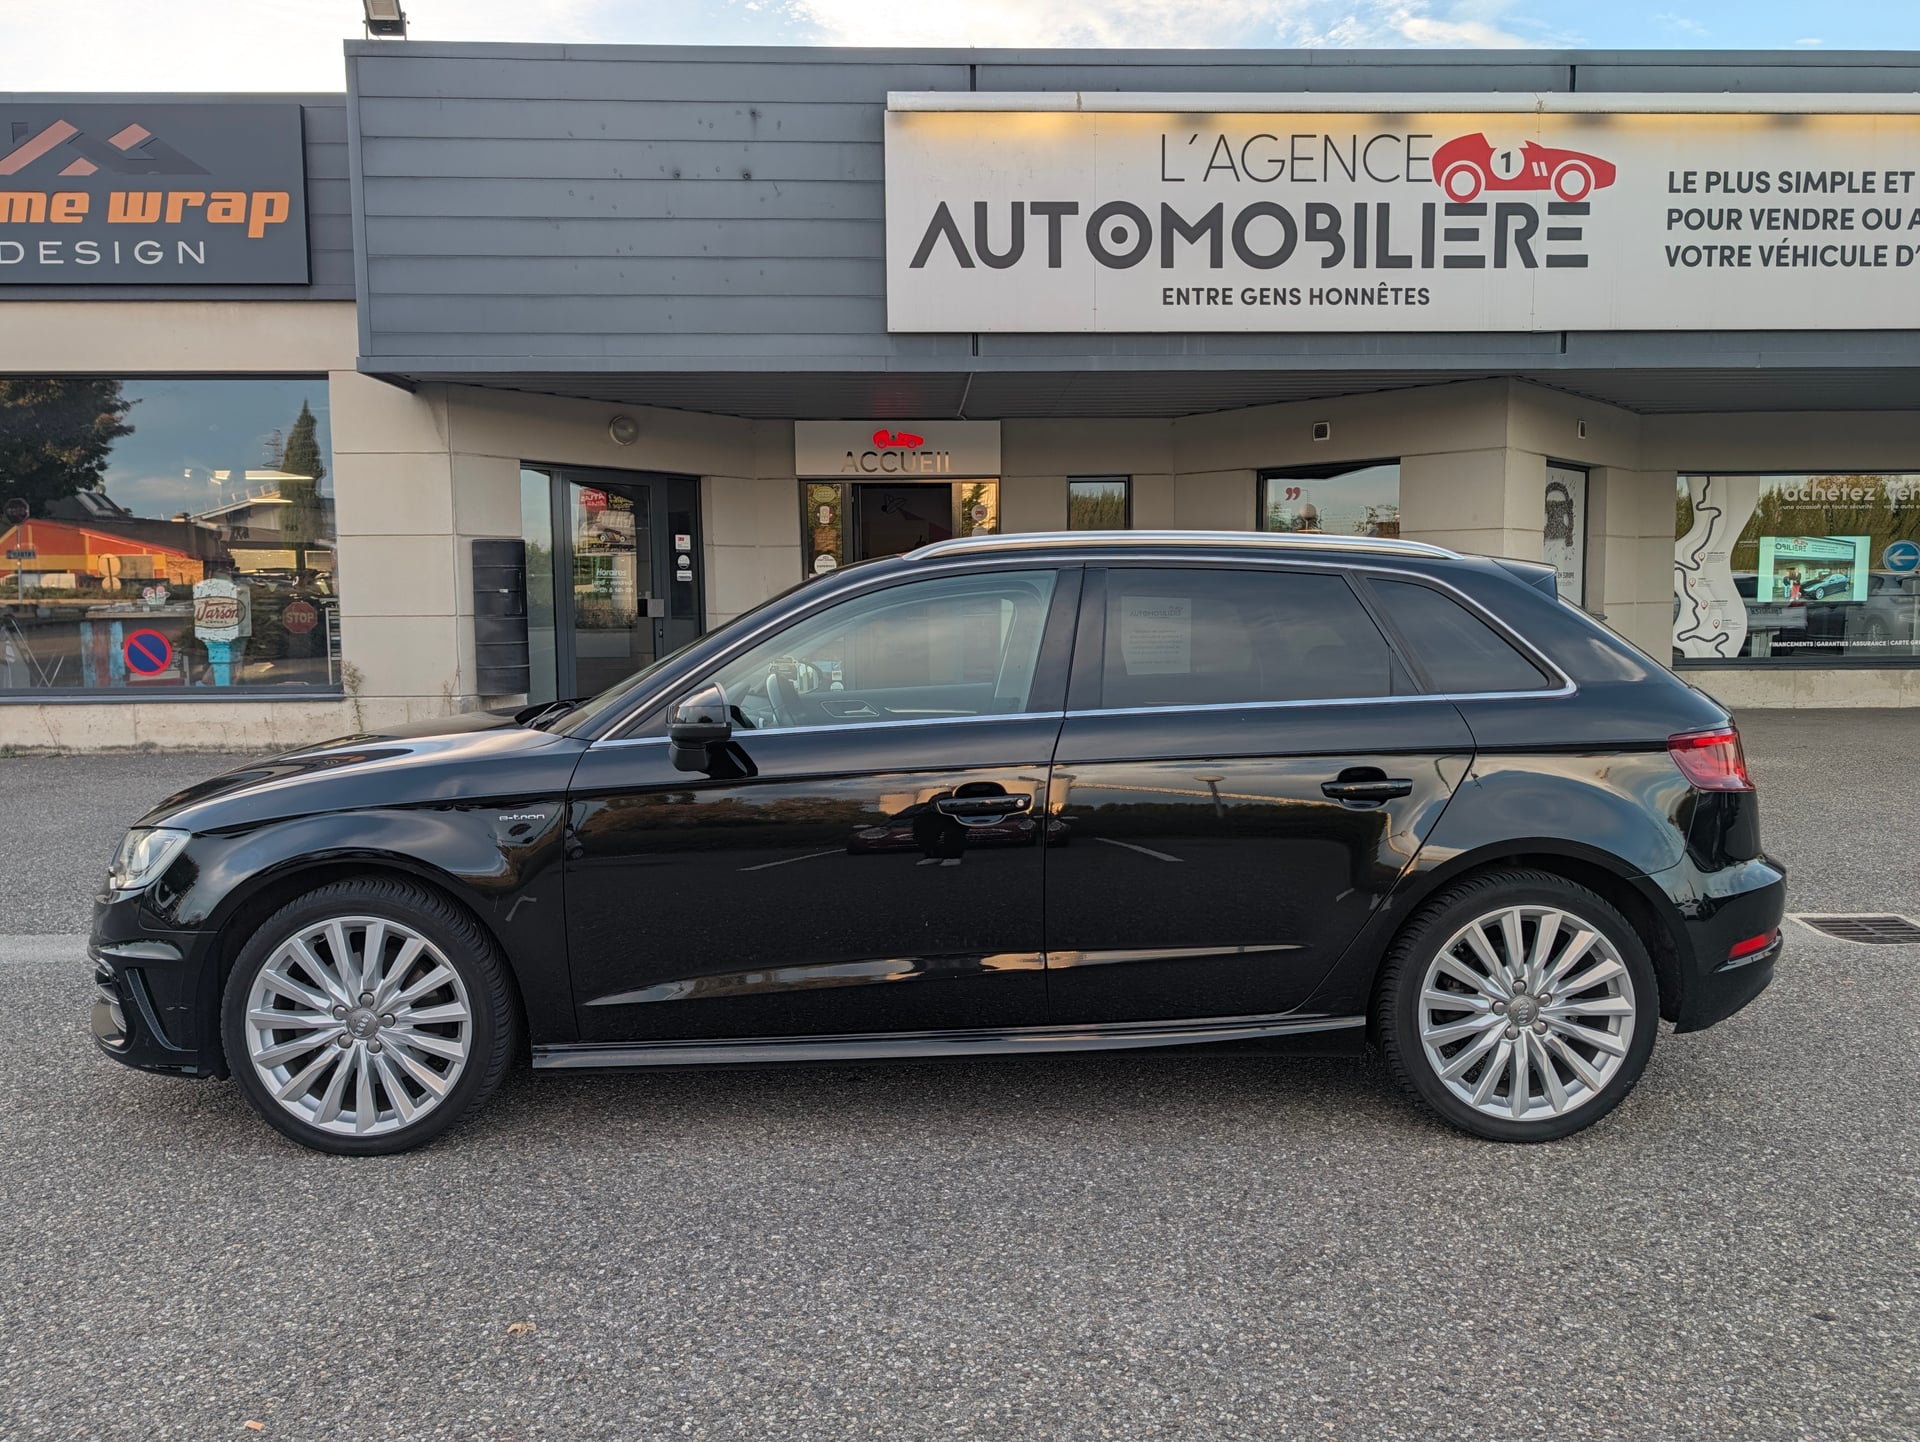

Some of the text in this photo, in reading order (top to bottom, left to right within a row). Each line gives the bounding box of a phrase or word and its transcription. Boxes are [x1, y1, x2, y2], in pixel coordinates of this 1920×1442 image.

[1668, 171, 1915, 193] LE PLUS SIMPLE ET
[108, 192, 290, 238] wrap
[1667, 208, 1743, 230] POUR
[1750, 208, 1854, 230] VENDRE
[1862, 208, 1902, 230] OU
[0, 241, 205, 265] DESIGN
[1665, 245, 1752, 267] VOTRE
[1759, 238, 1888, 267] VÉHICULE
[1162, 281, 1430, 305] ENTRE GENS HONNÊTES
[841, 451, 957, 473] ACCUEIL
[1785, 478, 1875, 501] achetez
[287, 612, 313, 623] STOP
